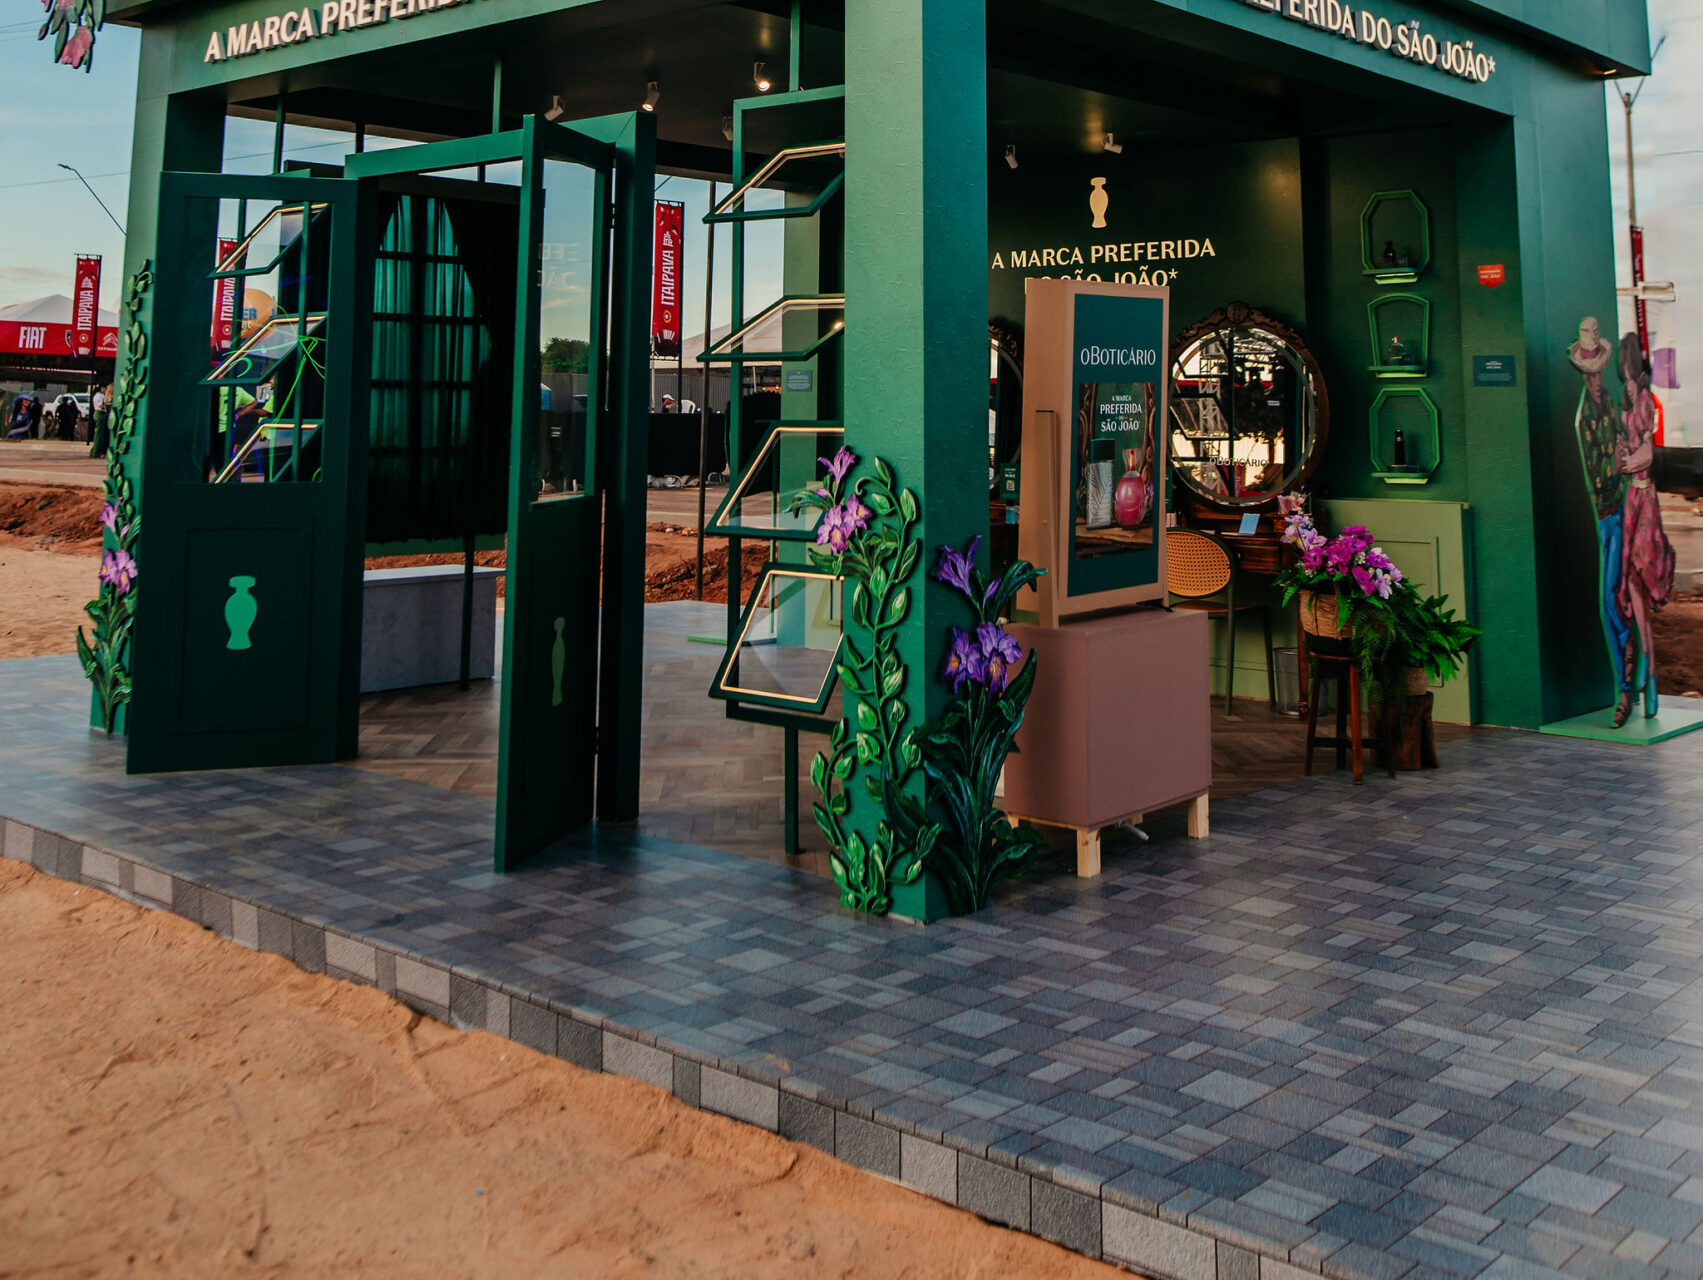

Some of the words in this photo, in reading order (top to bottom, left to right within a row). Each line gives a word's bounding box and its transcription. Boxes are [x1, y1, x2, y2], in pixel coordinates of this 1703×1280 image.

[203, 30, 229, 63] A
[227, 6, 319, 58] MARCA
[1356, 10, 1393, 51] DO
[1393, 20, 1437, 65] SÃO
[991, 252, 1005, 270] A
[1011, 247, 1084, 269] MARCA
[1091, 238, 1216, 264] PREFERIDA
[661, 250, 674, 306] ITAIPAVA
[77, 290, 93, 331] ITAIPAVA
[18, 326, 47, 349] FIAT
[1100, 403, 1142, 414] PREFERIDA
[1101, 419, 1117, 432] SÃO
